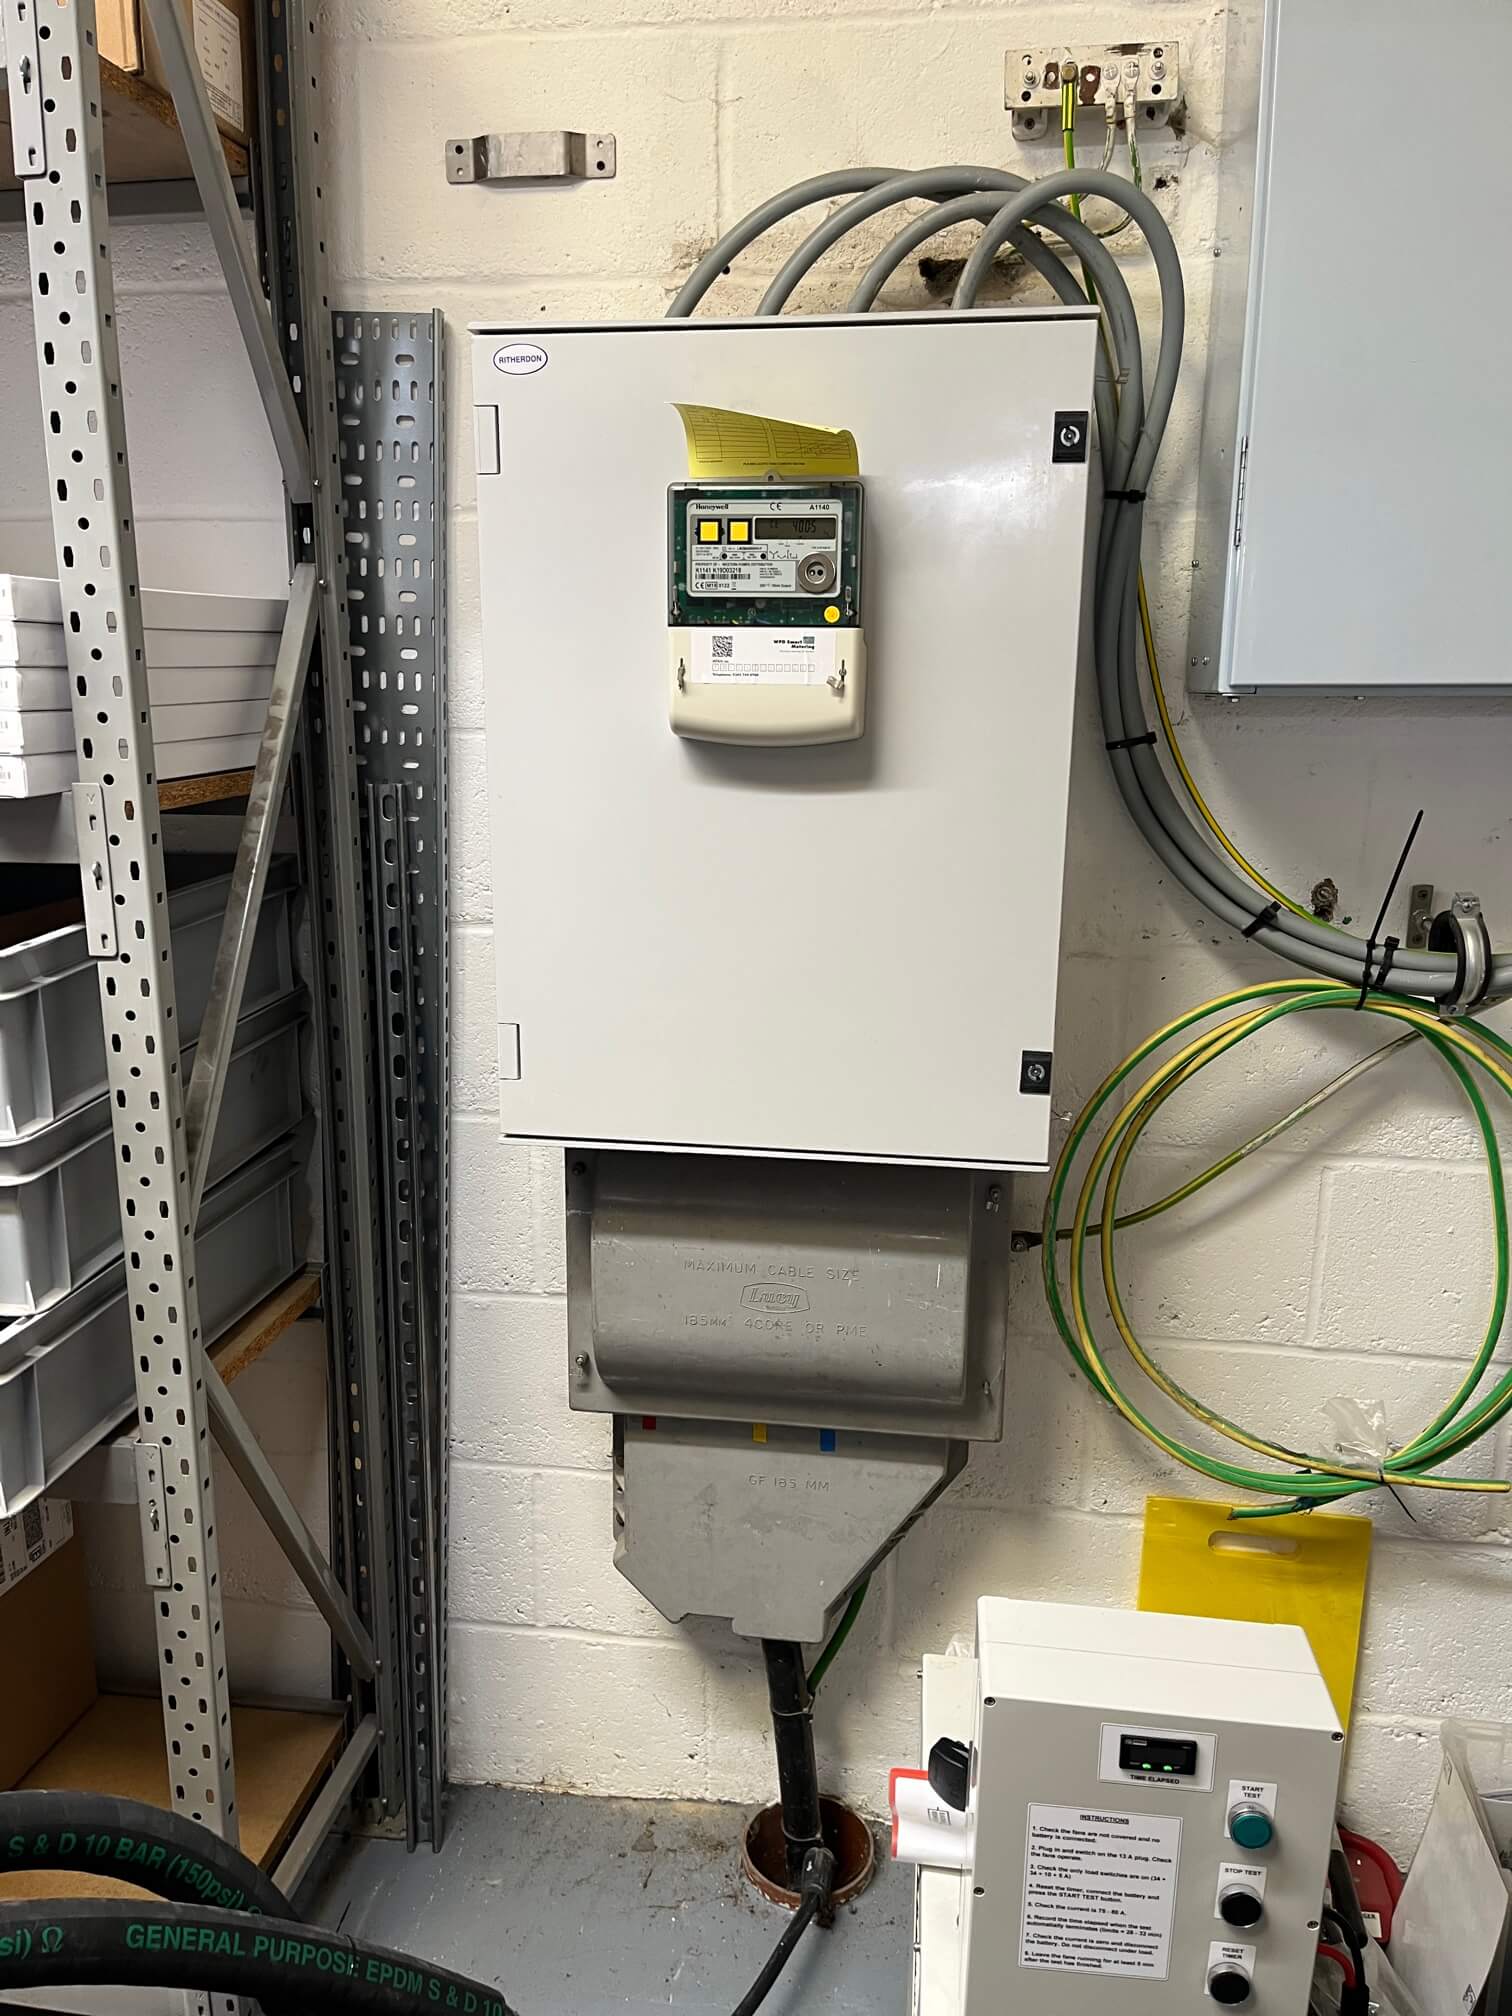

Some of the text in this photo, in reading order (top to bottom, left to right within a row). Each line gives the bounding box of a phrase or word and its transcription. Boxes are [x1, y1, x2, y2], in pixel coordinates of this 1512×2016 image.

[498, 354, 543, 365] RITHERDON
[695, 503, 729, 511] Honeywell
[683, 1259, 860, 1282] MAXIMUM CABLE SIZE
[748, 1287, 801, 1308] Lucy
[805, 1480, 830, 1491] MM
[1130, 1774, 1180, 1784] TIME ELAPSED
[1241, 1785, 1264, 1793] START
[1079, 1814, 1129, 1824] INSTRUCTIONS
[8, 1832, 247, 1911] S & D 10 BAR (150psi)
[1099, 1870, 1127, 1878] switches
[1058, 1891, 1079, 1899] START
[1222, 1946, 1244, 1954] RESET
[1222, 1952, 1243, 1960] TIMER
[125, 1923, 246, 1957] GENERAL
[365, 1957, 424, 1996] EPDM
[427, 1977, 442, 2001] S
[446, 1984, 459, 2009] &
[463, 1990, 478, 2014] D
